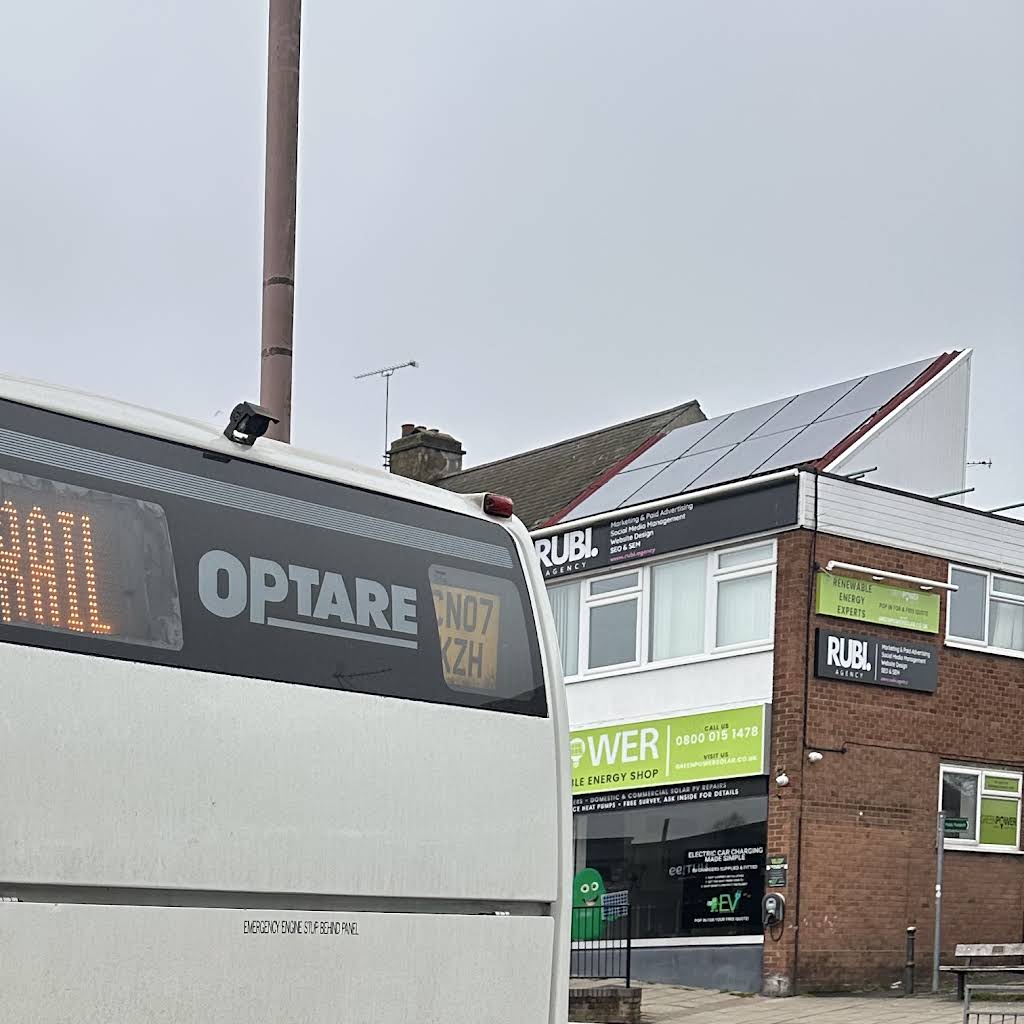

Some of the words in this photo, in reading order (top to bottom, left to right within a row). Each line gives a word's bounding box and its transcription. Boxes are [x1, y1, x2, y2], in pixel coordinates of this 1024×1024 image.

[610, 516, 640, 528] Marketing
[646, 511, 659, 519] Paid
[660, 503, 694, 516] Advertising
[610, 527, 627, 536] Social
[629, 523, 646, 532] Media
[647, 513, 686, 528] Management
[610, 534, 633, 545] Website
[634, 530, 654, 540] Design
[610, 546, 622, 554] SEO
[629, 541, 641, 549] SEM
[546, 562, 586, 576] AGENCY
[198, 549, 418, 636] OPTARE
[833, 578, 872, 593] RENEWABLE
[839, 592, 865, 604] ENERGY
[837, 605, 866, 618] EXPERTS
[827, 636, 872, 672] RUBI.
[835, 669, 864, 679] AGENCY
[676, 733, 705, 746] 0800
[708, 730, 728, 742] 015
[732, 726, 758, 739] 1478
[588, 772, 627, 785] ENERGY
[630, 769, 658, 780] SHOP
[581, 803, 595, 811] HEAT
[597, 802, 616, 810] PUMPS
[623, 799, 637, 807] FREE
[677, 793, 697, 801] INSIDE
[699, 791, 712, 799] FOR
[714, 788, 739, 797] DETAILS
[589, 794, 620, 803] DOMESTIC
[628, 788, 668, 799] COMMERCIAL
[670, 786, 690, 794] SOLAR
[702, 782, 727, 791] REPAIRS
[688, 849, 716, 859] ELECTRIC
[730, 847, 764, 855] CHARGING
[705, 855, 722, 863] MADE
[719, 890, 742, 913] EV
[243, 921, 280, 934] EMERGENCY
[281, 921, 302, 934] ENGINE
[320, 921, 340, 934] BEHIND
[342, 922, 359, 935] PANEL
